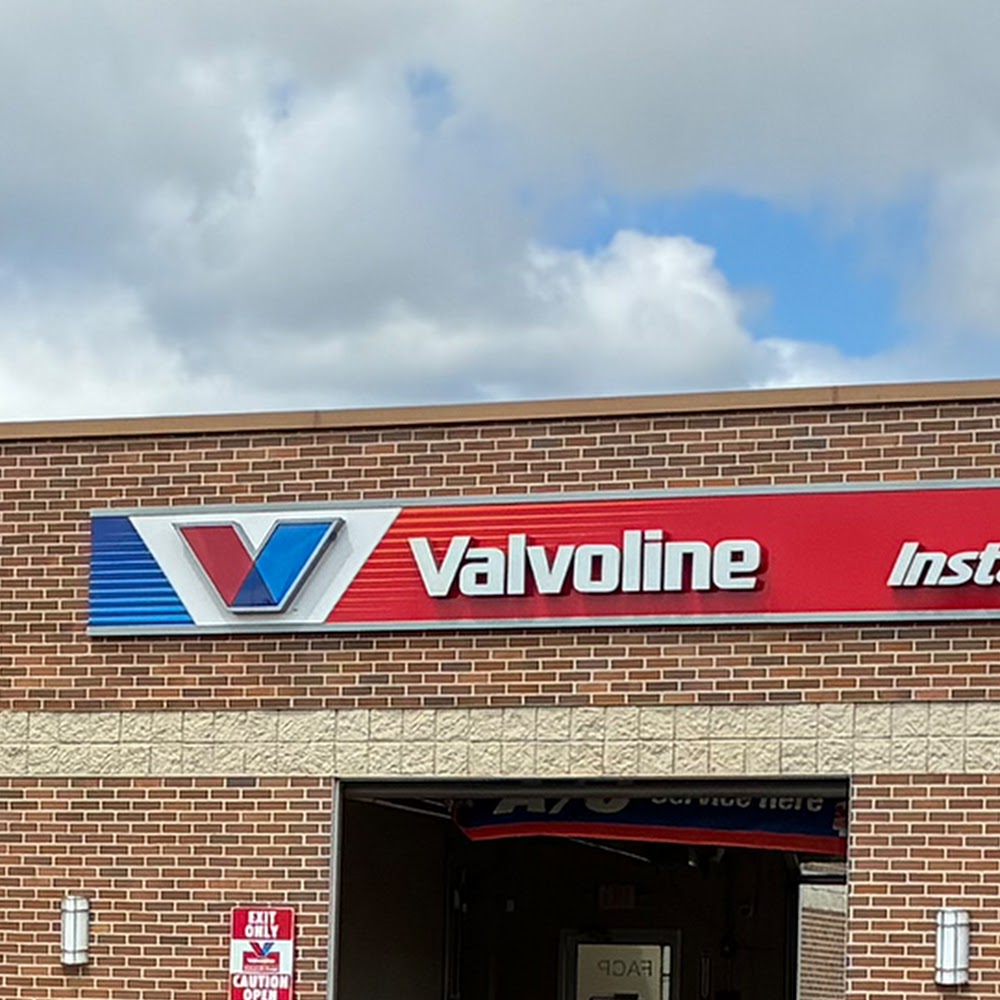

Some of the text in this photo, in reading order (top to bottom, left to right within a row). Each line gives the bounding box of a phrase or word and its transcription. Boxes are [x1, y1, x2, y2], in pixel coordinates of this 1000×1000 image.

[407, 529, 761, 598] Valvoline
[247, 910, 277, 924] EXIT
[244, 924, 279, 938] ONLY
[232, 974, 289, 989] CAUTION
